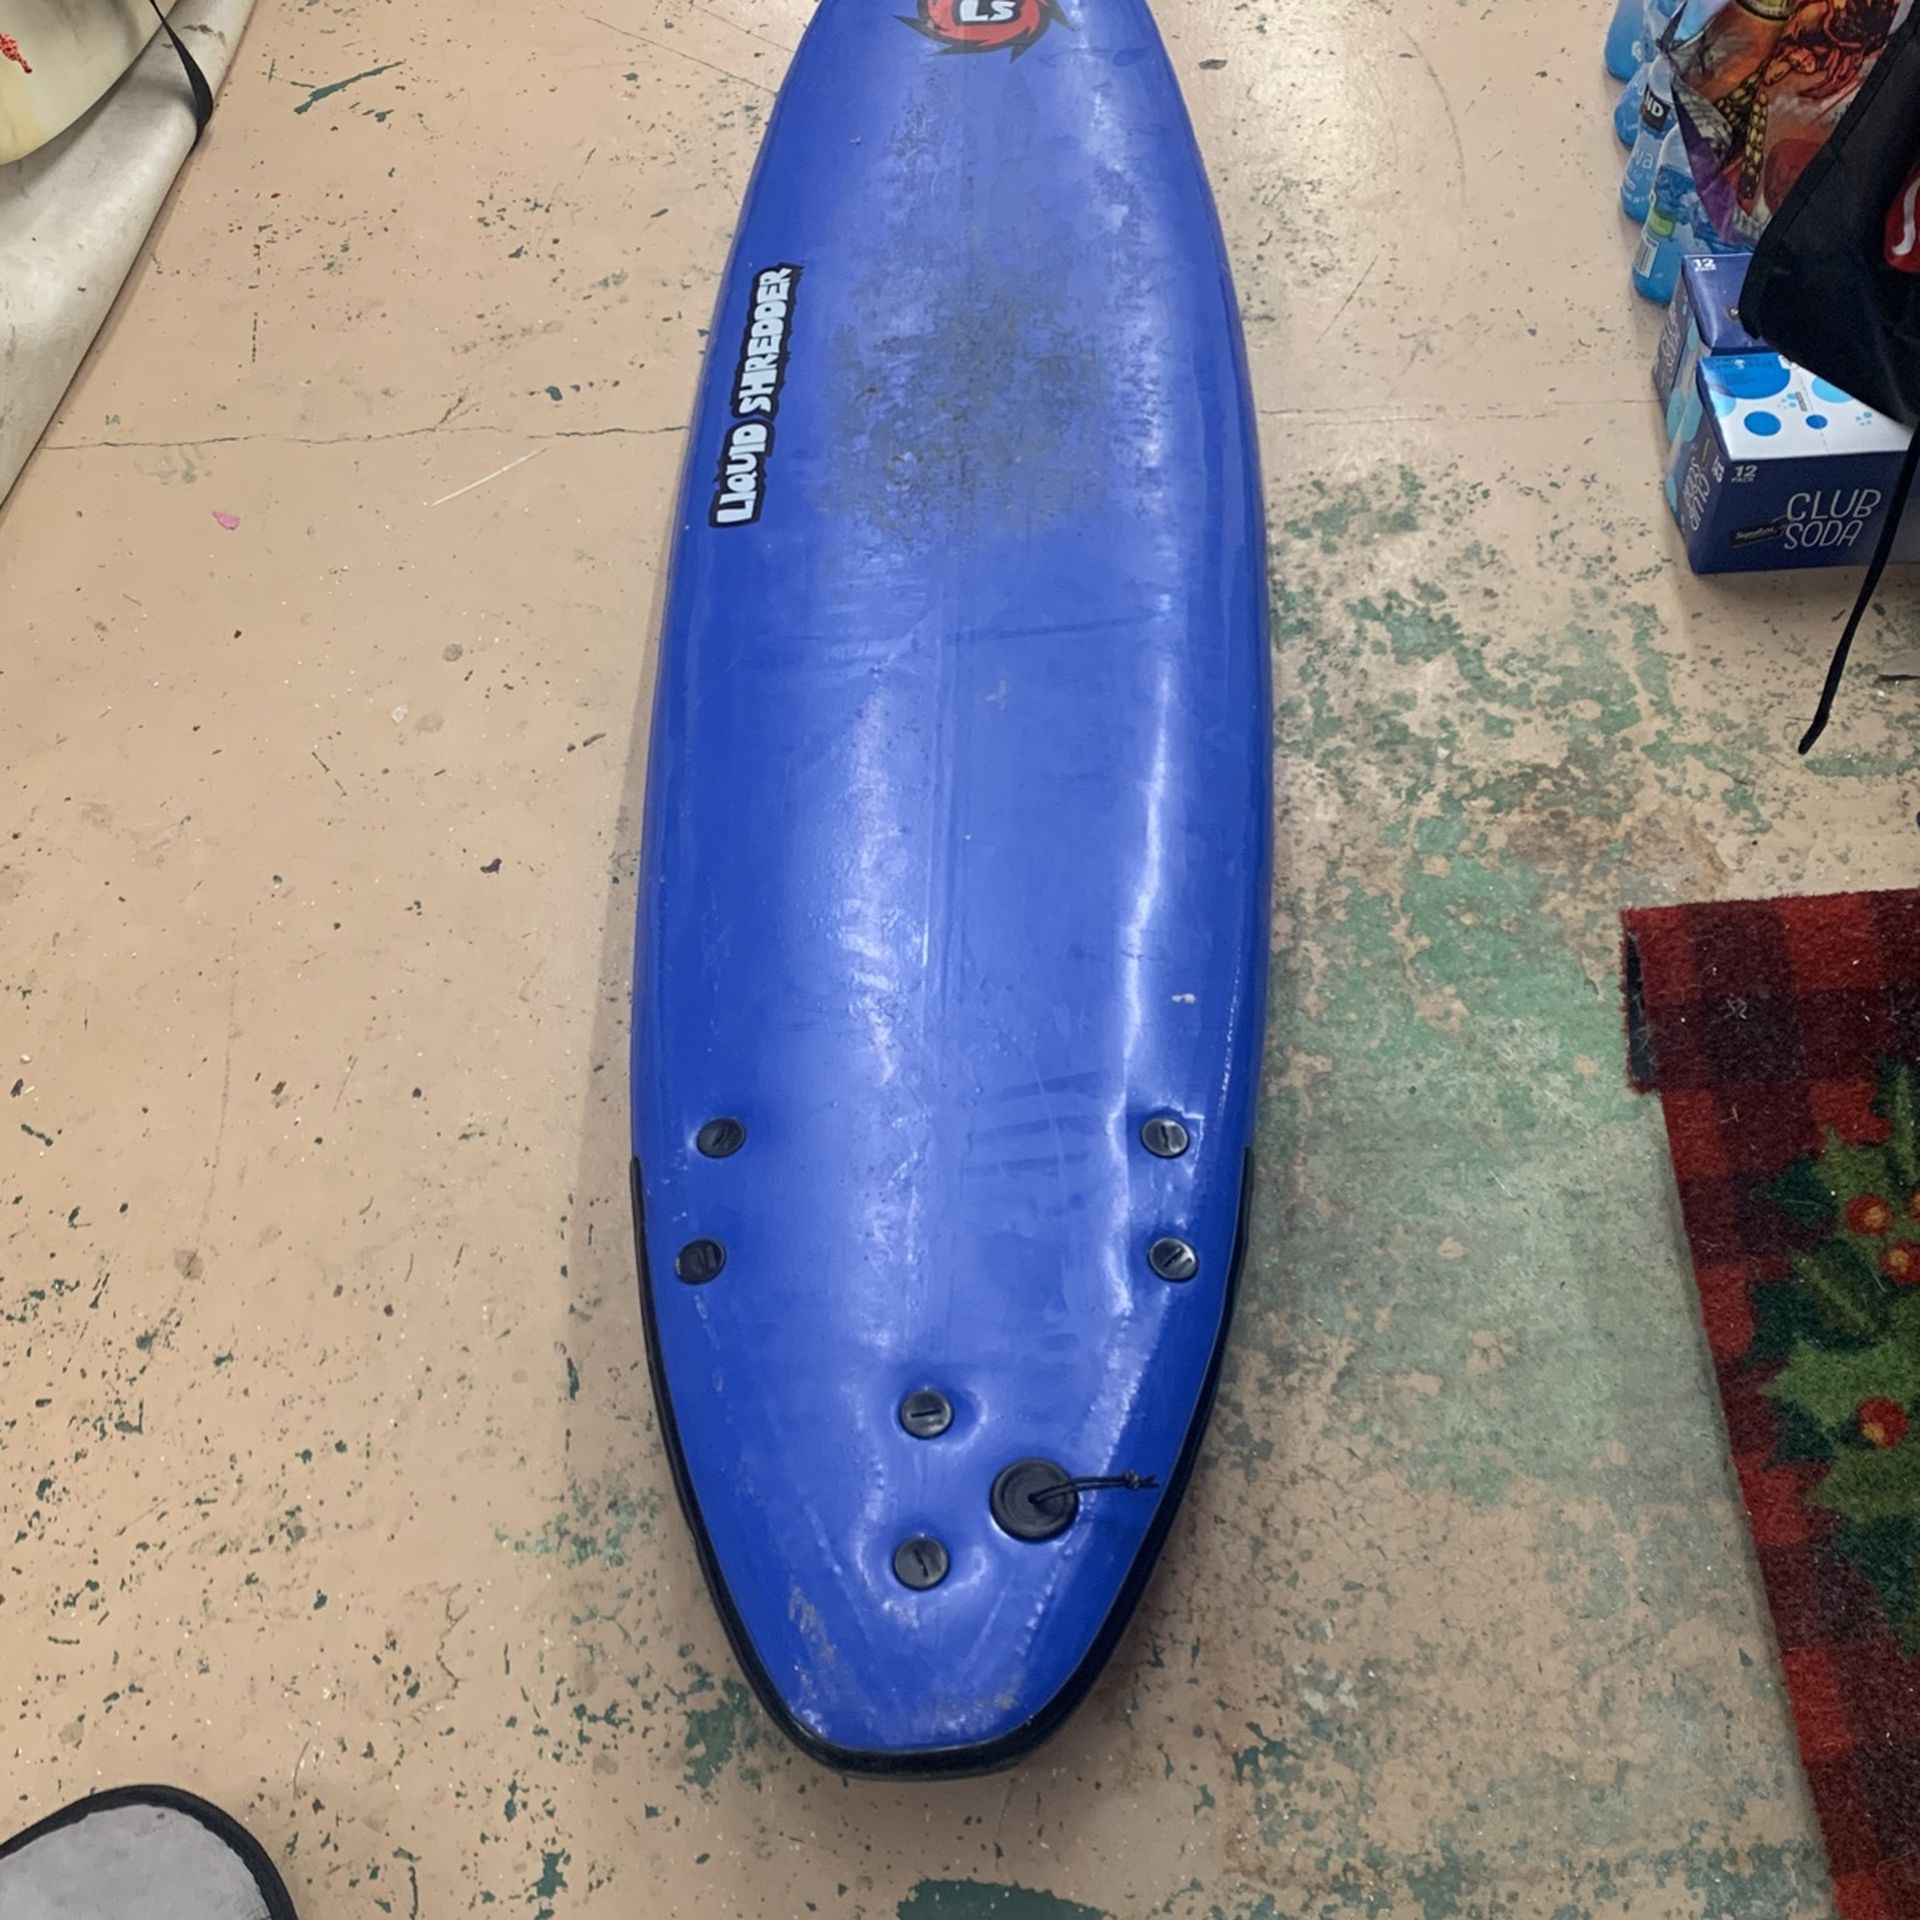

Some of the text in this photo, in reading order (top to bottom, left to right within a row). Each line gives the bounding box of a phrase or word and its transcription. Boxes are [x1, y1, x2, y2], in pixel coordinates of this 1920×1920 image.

[717, 267, 792, 523] LIQUID SHREDDER
[1735, 465, 1758, 477] 12
[1786, 488, 1882, 521] CLUB
[1784, 520, 1864, 550] SODA
